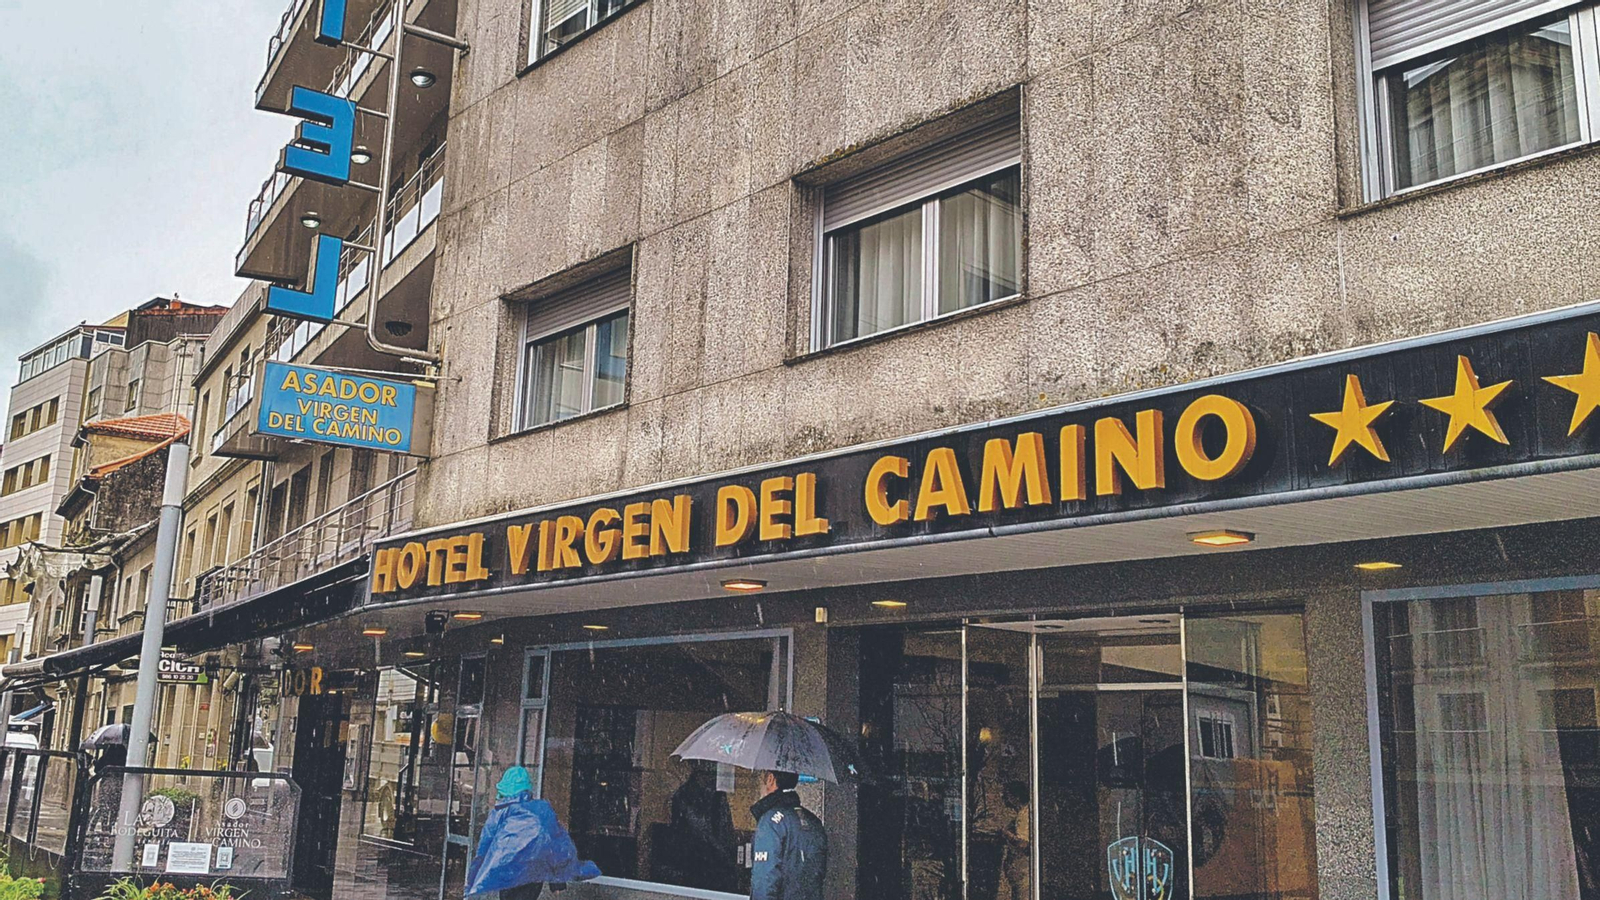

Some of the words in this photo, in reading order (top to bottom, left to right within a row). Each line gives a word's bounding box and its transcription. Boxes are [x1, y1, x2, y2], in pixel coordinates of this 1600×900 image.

[280, 370, 398, 407] ASADOR
[297, 398, 378, 425] VIRGEN
[267, 411, 305, 432] DEL
[312, 417, 402, 445] CAMINO
[371, 531, 490, 594] HOTEL
[507, 494, 692, 575] VIRGEN
[715, 472, 829, 547] DEL
[865, 394, 1257, 526] CAMINO
[124, 811, 143, 826] LA
[205, 827, 250, 838] VIRGEN
[212, 837, 261, 849] CAMINO
[754, 851, 768, 862] HH
